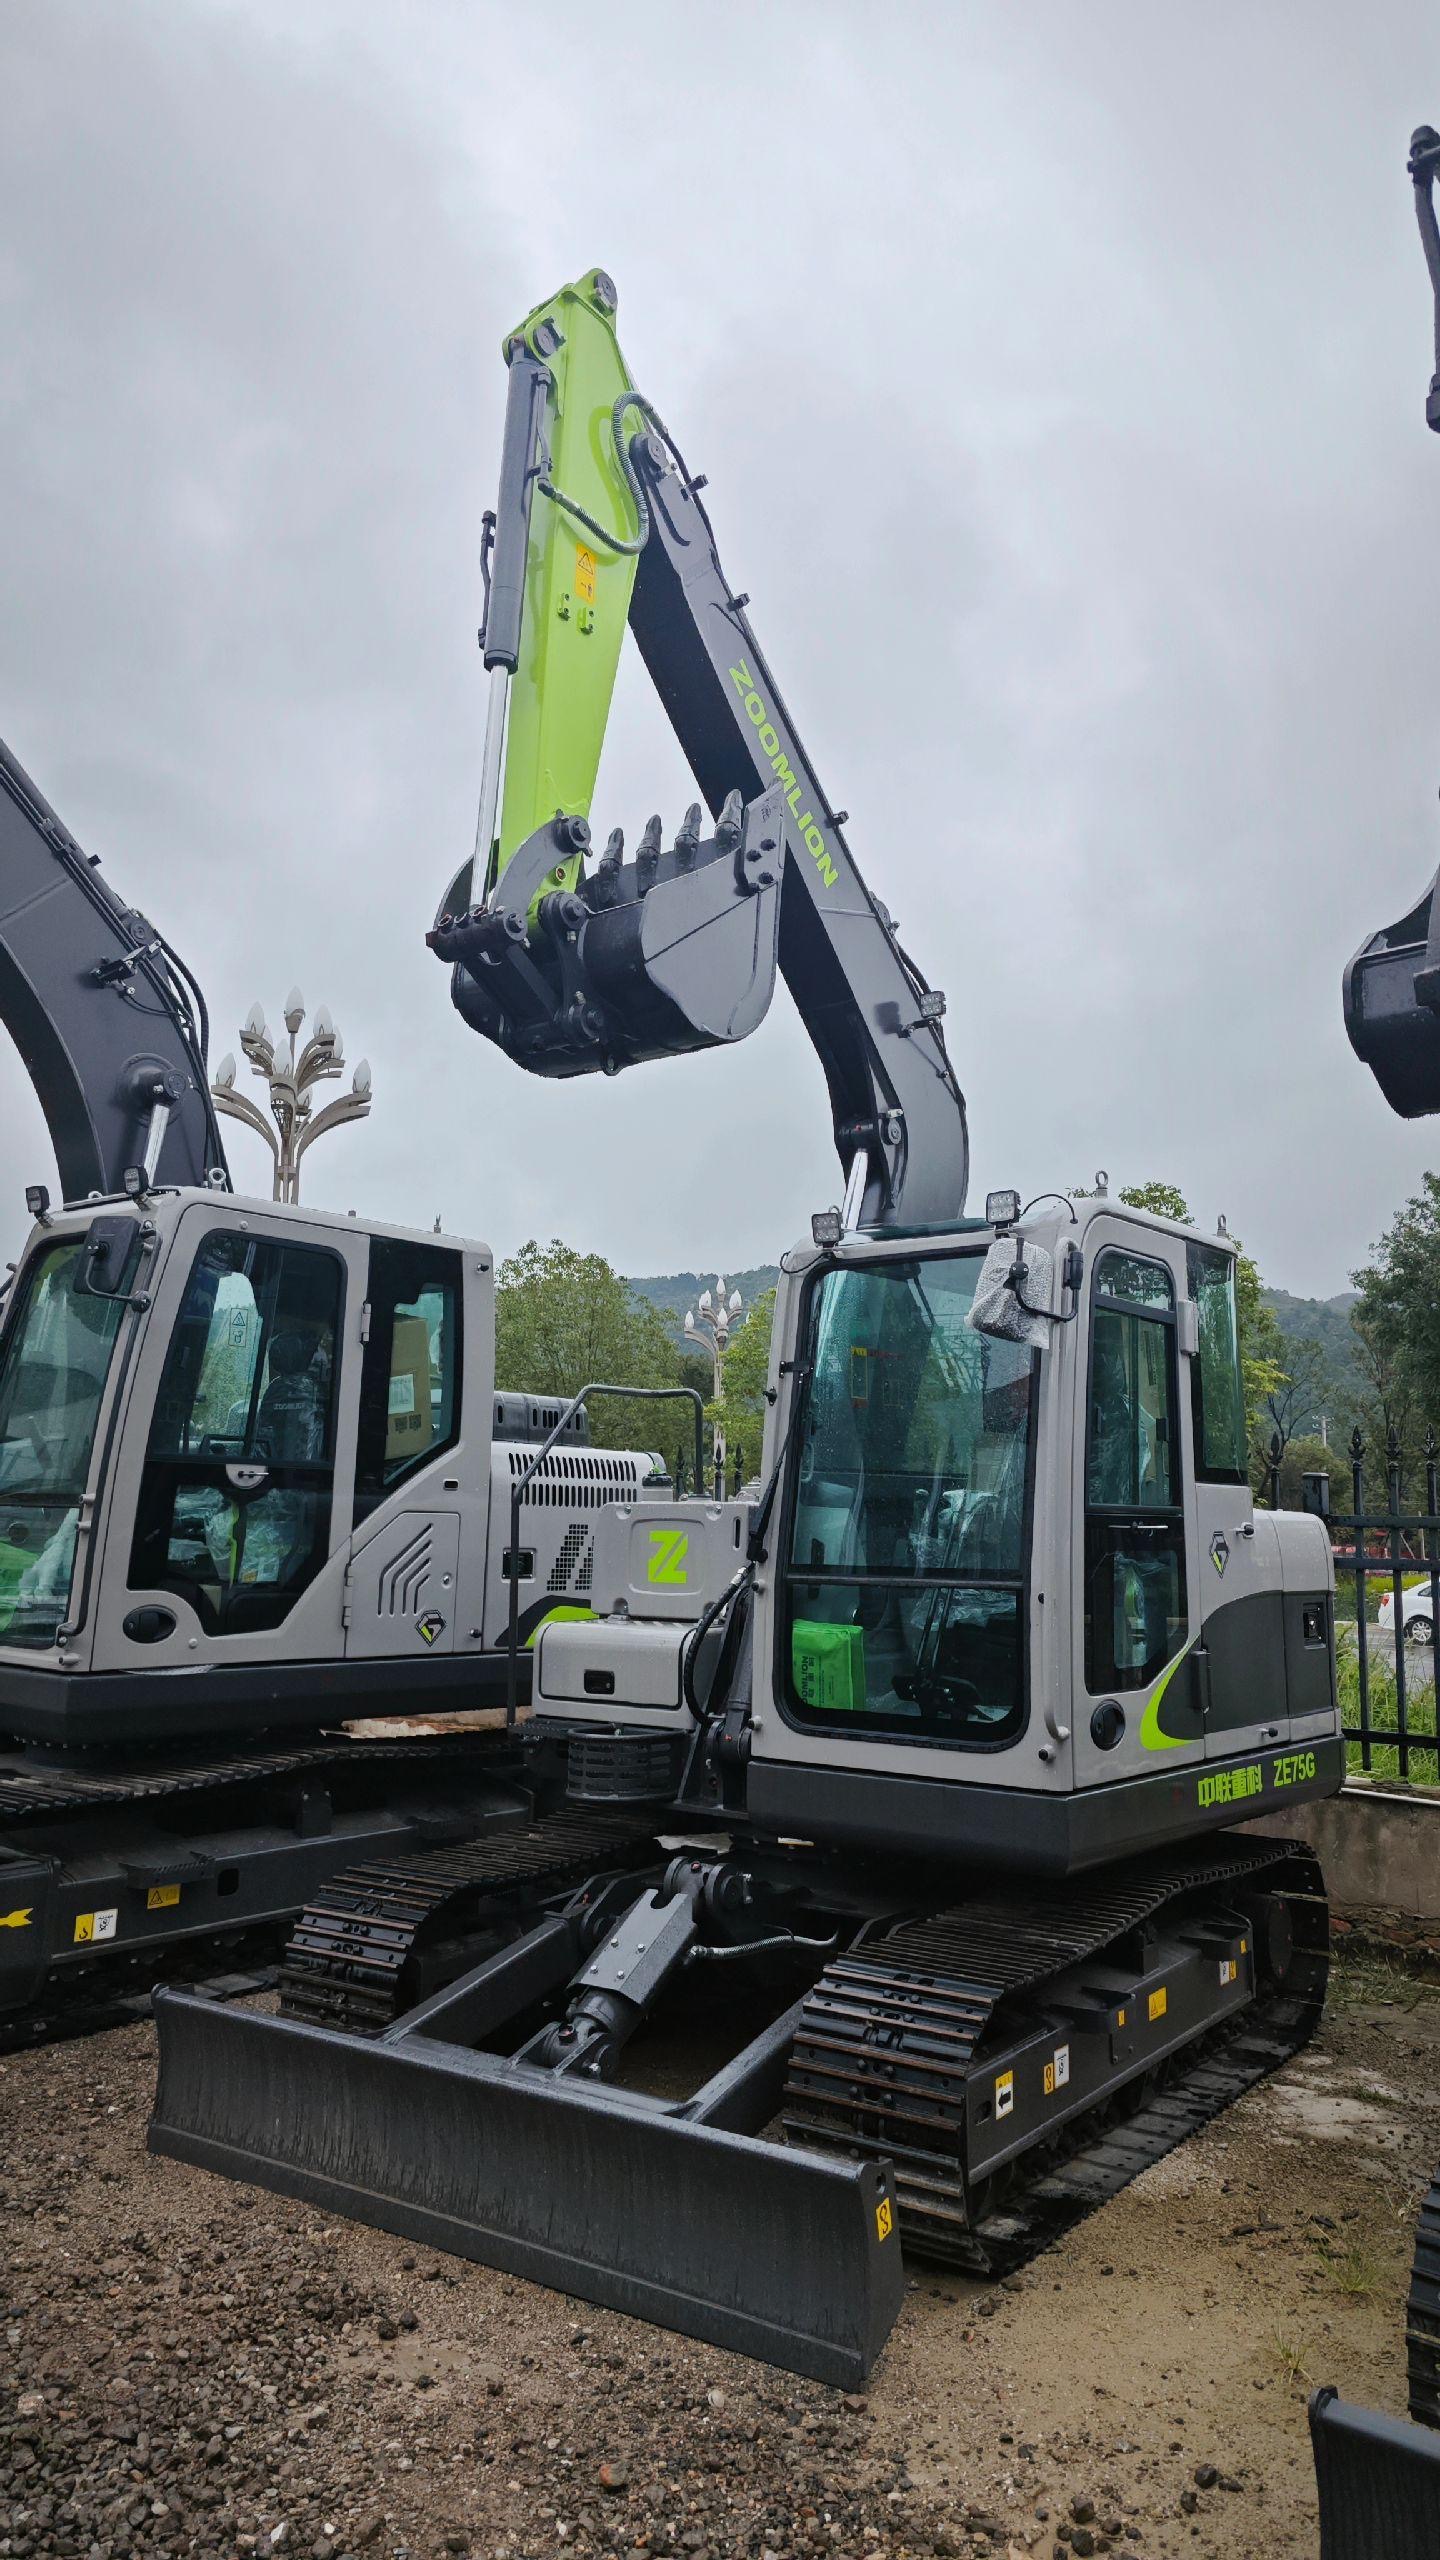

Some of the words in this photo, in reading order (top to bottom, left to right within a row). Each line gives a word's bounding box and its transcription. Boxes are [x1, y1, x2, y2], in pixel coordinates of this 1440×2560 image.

[728, 658, 839, 889] ZOOMLION
[1198, 1763, 1263, 1808] 中联重科
[1273, 1752, 1316, 1787] ZE75G
